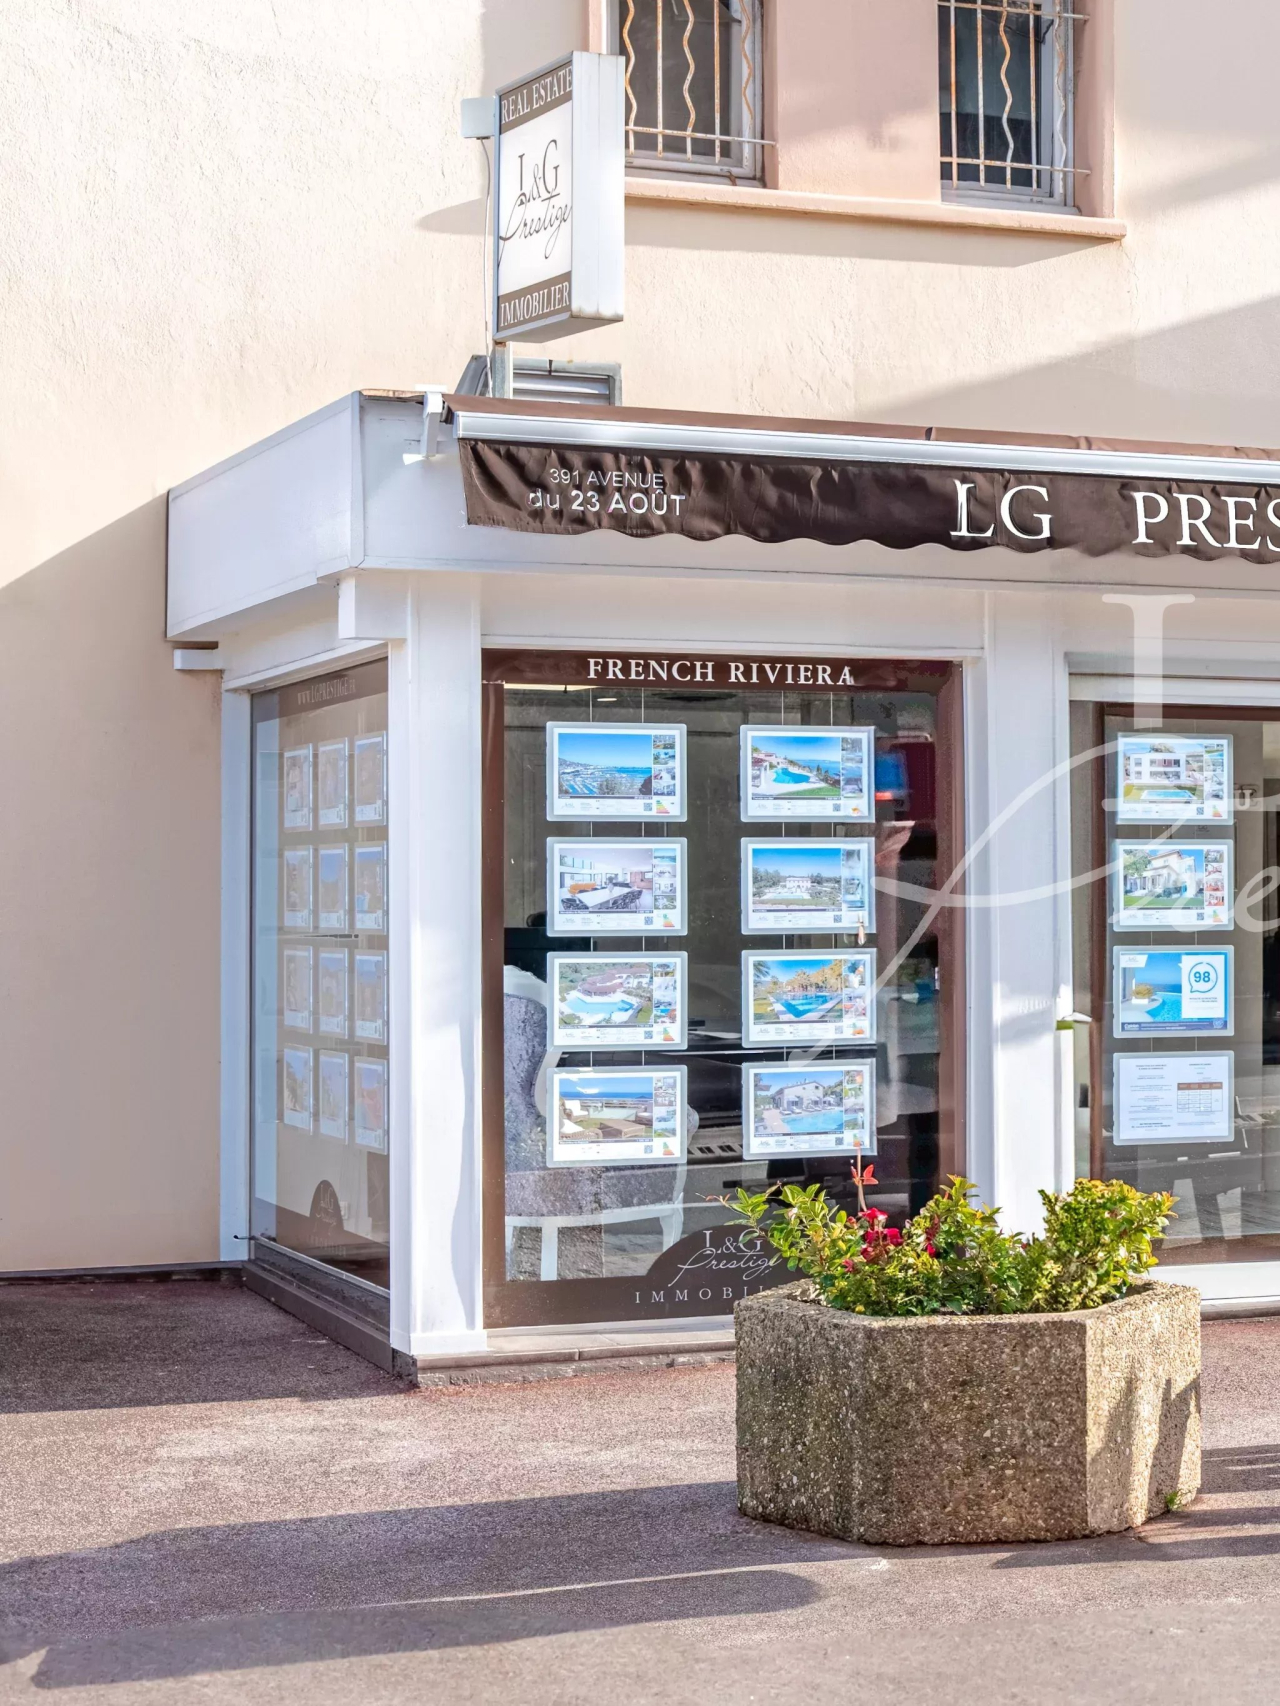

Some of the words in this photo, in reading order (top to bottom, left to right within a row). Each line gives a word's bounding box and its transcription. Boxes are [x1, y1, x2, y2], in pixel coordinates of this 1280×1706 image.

[501, 94, 531, 125] REAL
[533, 66, 573, 111] ESTATE
[517, 139, 561, 207] L&G
[498, 192, 573, 266] Prestige
[500, 281, 571, 328] IMMOBILIER
[549, 468, 580, 485] 391
[586, 470, 664, 489] AVENUE
[570, 489, 600, 512] 23
[607, 489, 686, 516] AOÛT
[949, 479, 1054, 540] LG
[587, 658, 715, 683] FRENCH
[728, 662, 856, 686] RIVIERA
[1193, 971, 1211, 984] 98
[702, 1228, 765, 1254] L&G
[635, 1285, 764, 1304] IMMOBI
